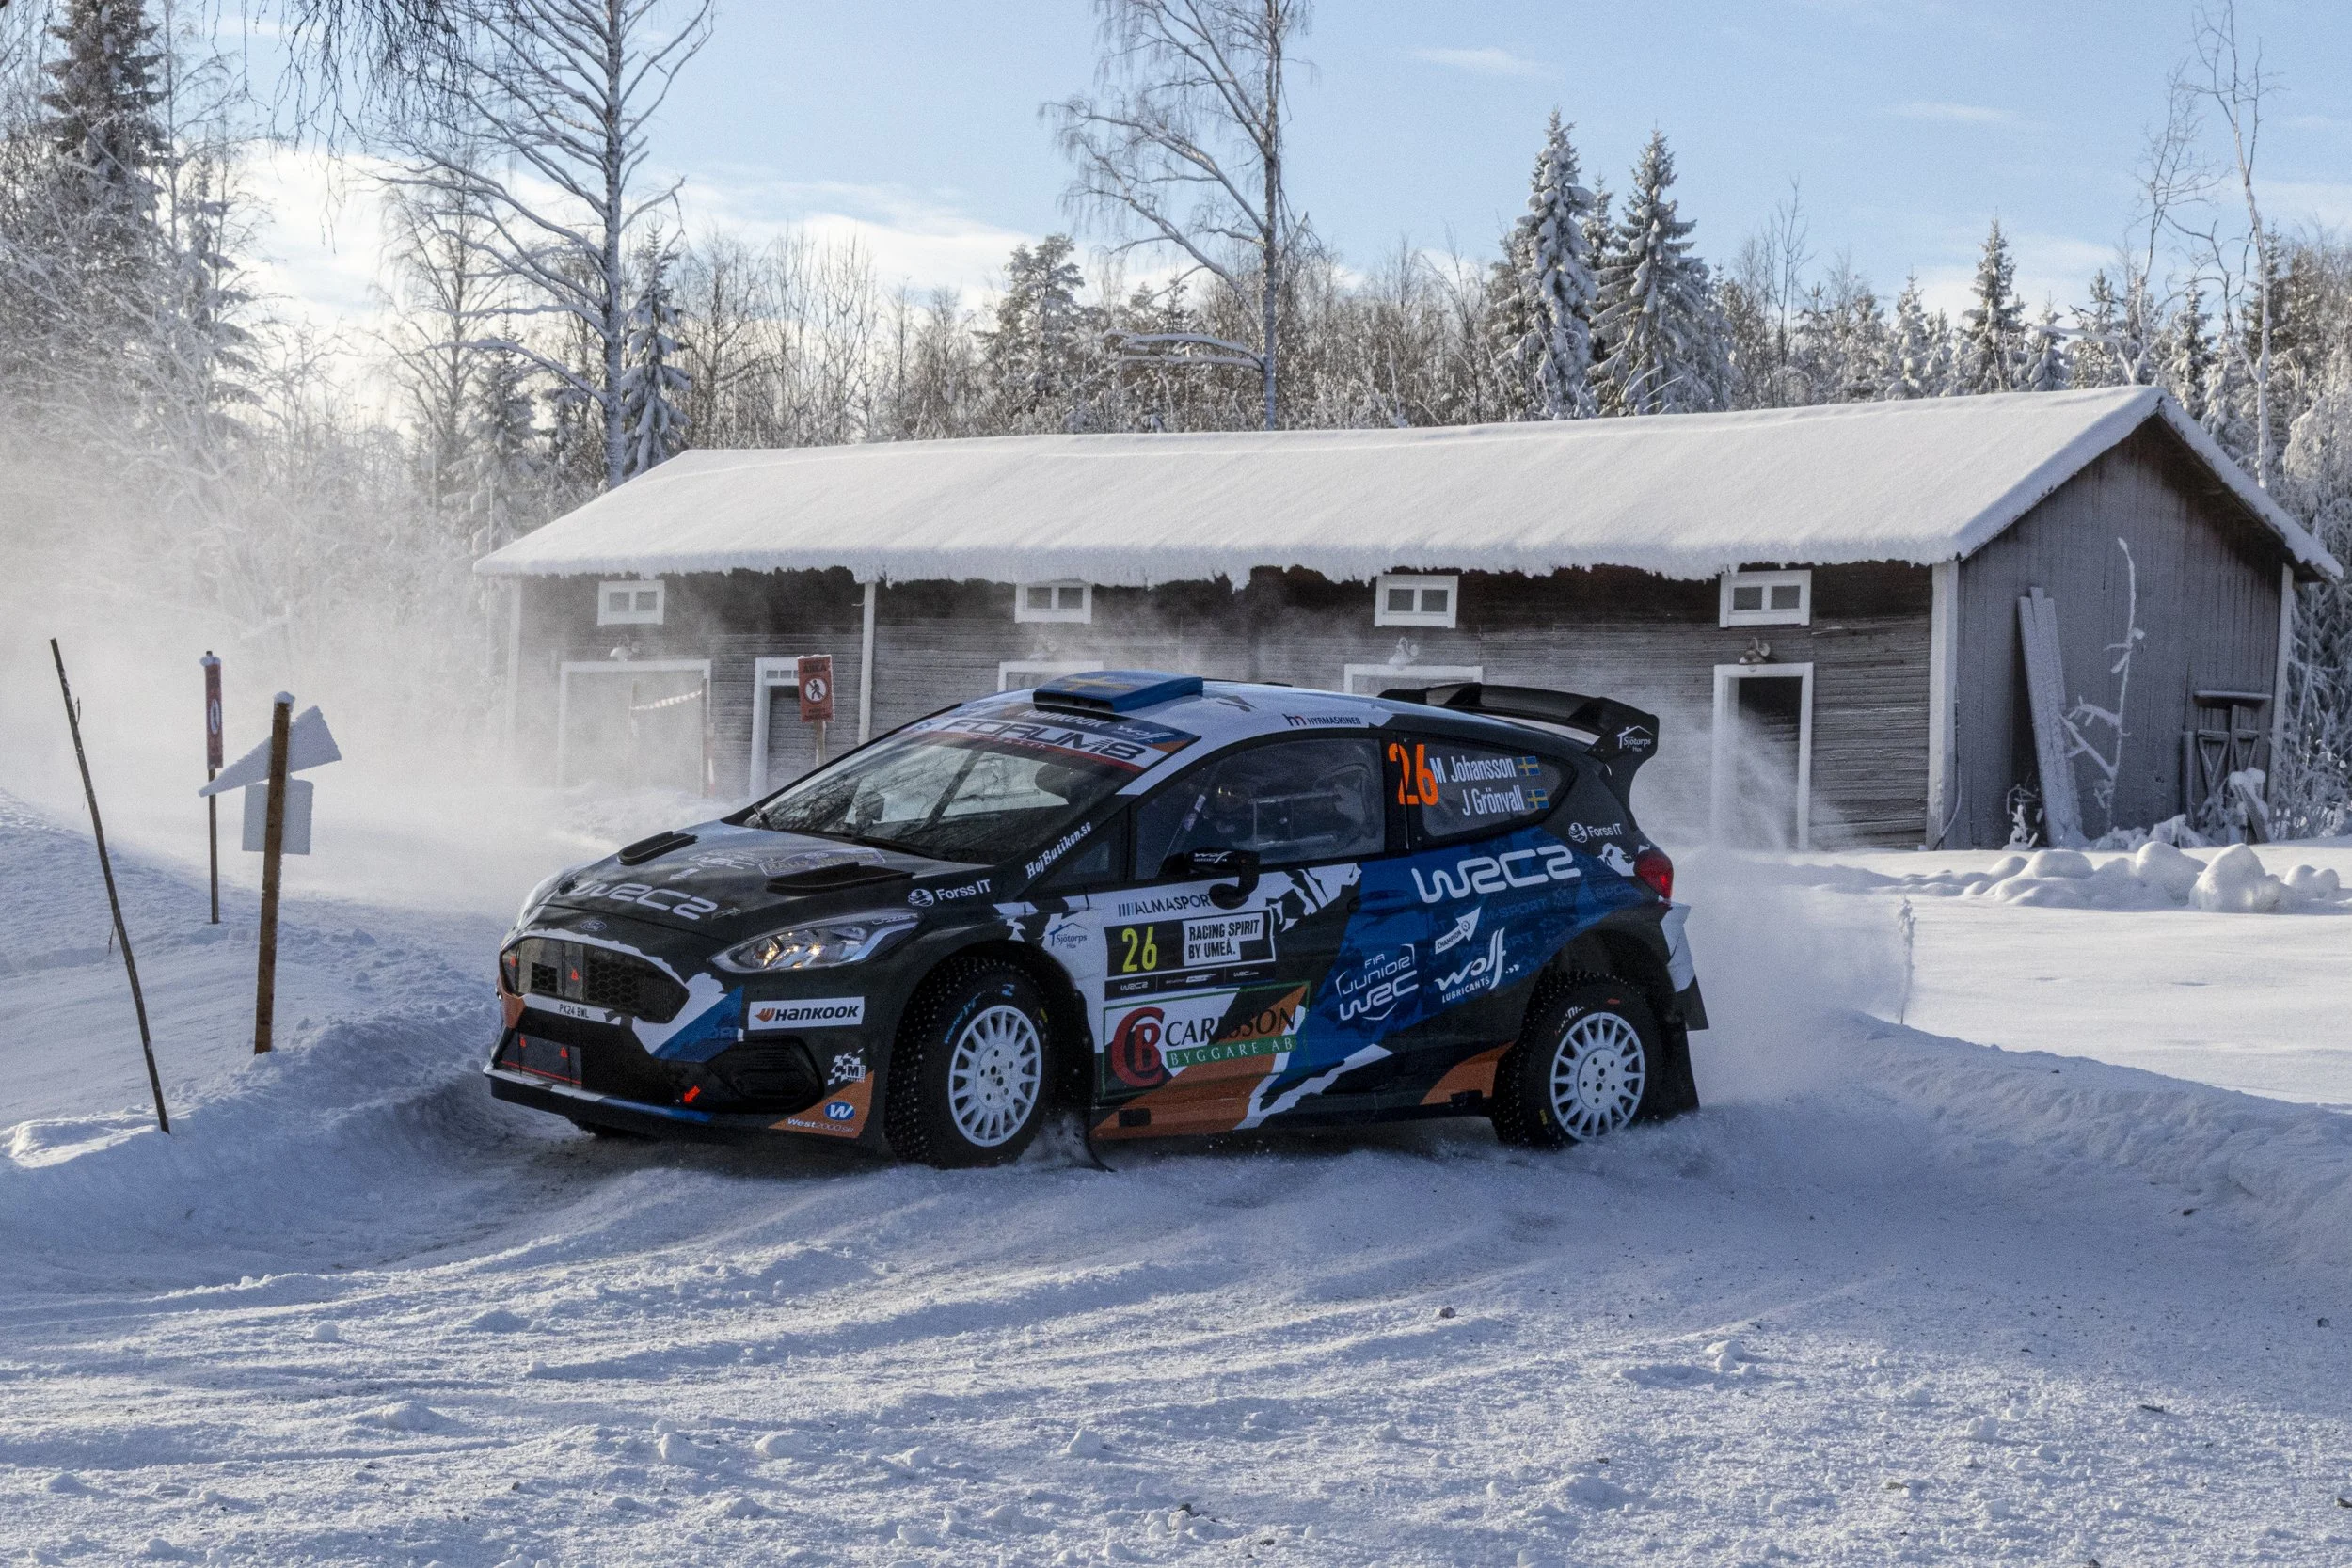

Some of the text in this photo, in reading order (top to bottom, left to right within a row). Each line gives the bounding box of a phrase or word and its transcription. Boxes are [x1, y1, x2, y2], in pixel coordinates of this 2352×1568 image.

[1307, 716, 1361, 725] HYRMASKINER
[942, 718, 1146, 760] FORUM8
[1623, 736, 1651, 749] Sjötorps
[1389, 742, 1439, 807] 26
[1429, 755, 1517, 784] M Johansson
[1462, 784, 1525, 816] J Grönvall
[1586, 823, 1623, 837] Forss IT
[1411, 845, 1581, 904] WRC2
[568, 881, 719, 920] WRC2
[935, 879, 991, 901] Forss IT
[1135, 894, 1212, 915] ALMASPOR
[1056, 933, 1088, 945] Sjötorps
[1188, 919, 1260, 942] RACING SPIRIT
[1437, 929, 1462, 950] CHAMPION
[1122, 926, 1158, 973] 26
[1188, 942, 1201, 959] BY
[1364, 953, 1385, 969] FIA
[1343, 955, 1411, 993] JUNIOR
[1120, 981, 1148, 991] WRC2
[1340, 970, 1420, 1021] WRC
[1441, 976, 1490, 1004] LUBRICANTS
[559, 1004, 590, 1019] PX24 BWL
[1171, 1037, 1293, 1066] BYGGARE AB
[829, 1104, 855, 1118] W
